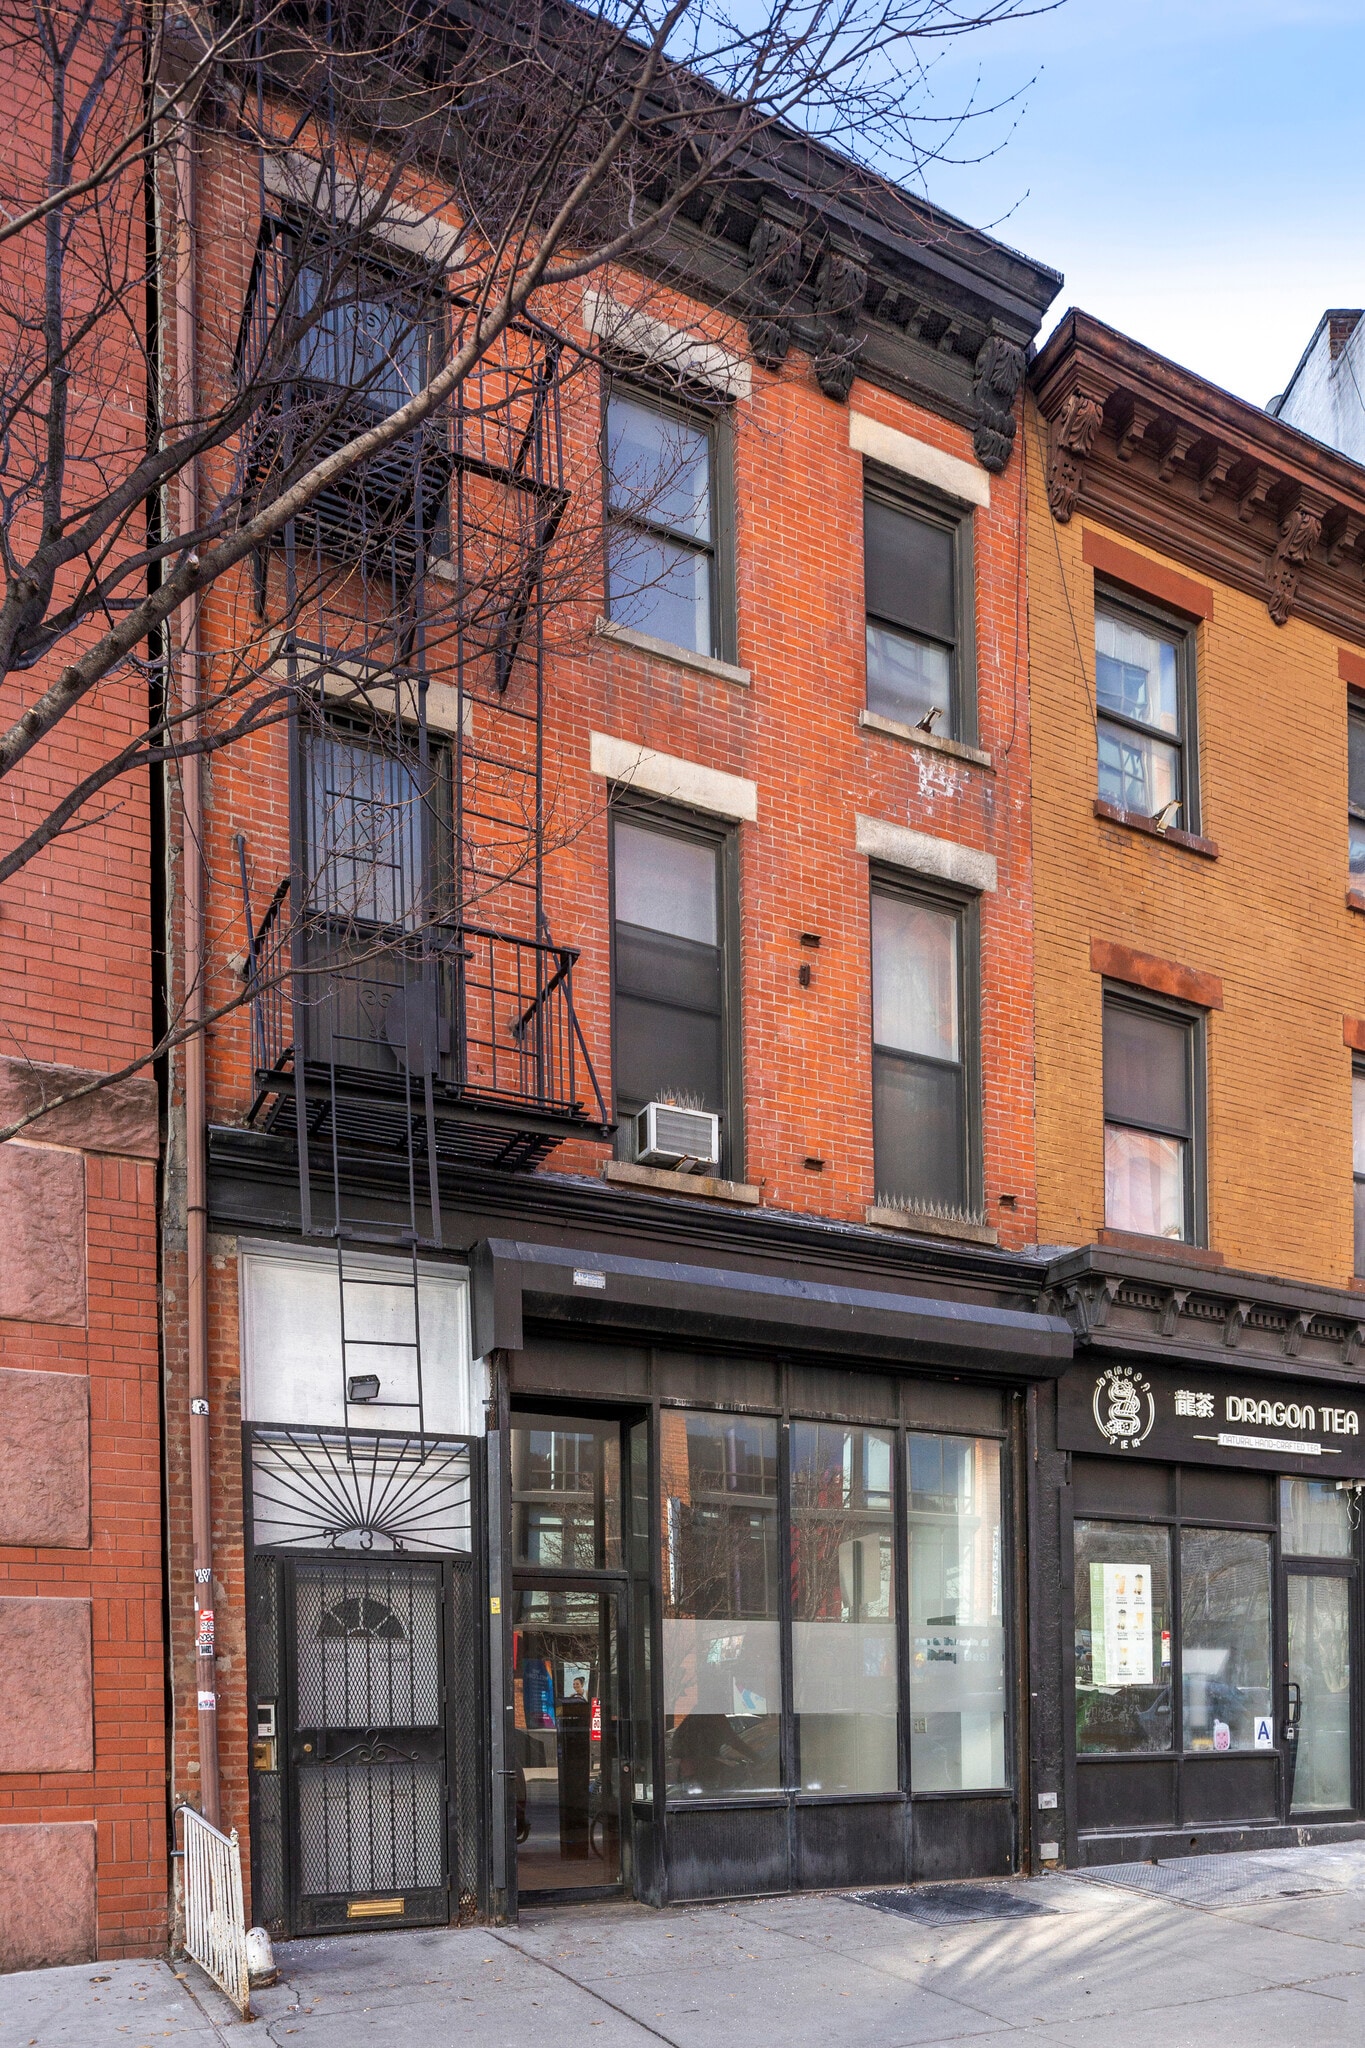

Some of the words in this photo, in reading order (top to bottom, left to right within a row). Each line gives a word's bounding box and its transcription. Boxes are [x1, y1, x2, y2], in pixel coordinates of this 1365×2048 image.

[1174, 1389, 1215, 1418] 龍茶
[1226, 1395, 1316, 1431] DRAGON
[1318, 1406, 1360, 1435] TEA
[1222, 1434, 1254, 1446] NATURAL
[1255, 1438, 1306, 1451] HAND-CRAFTED
[1307, 1444, 1319, 1452] TEA
[1257, 1720, 1270, 1740] A
